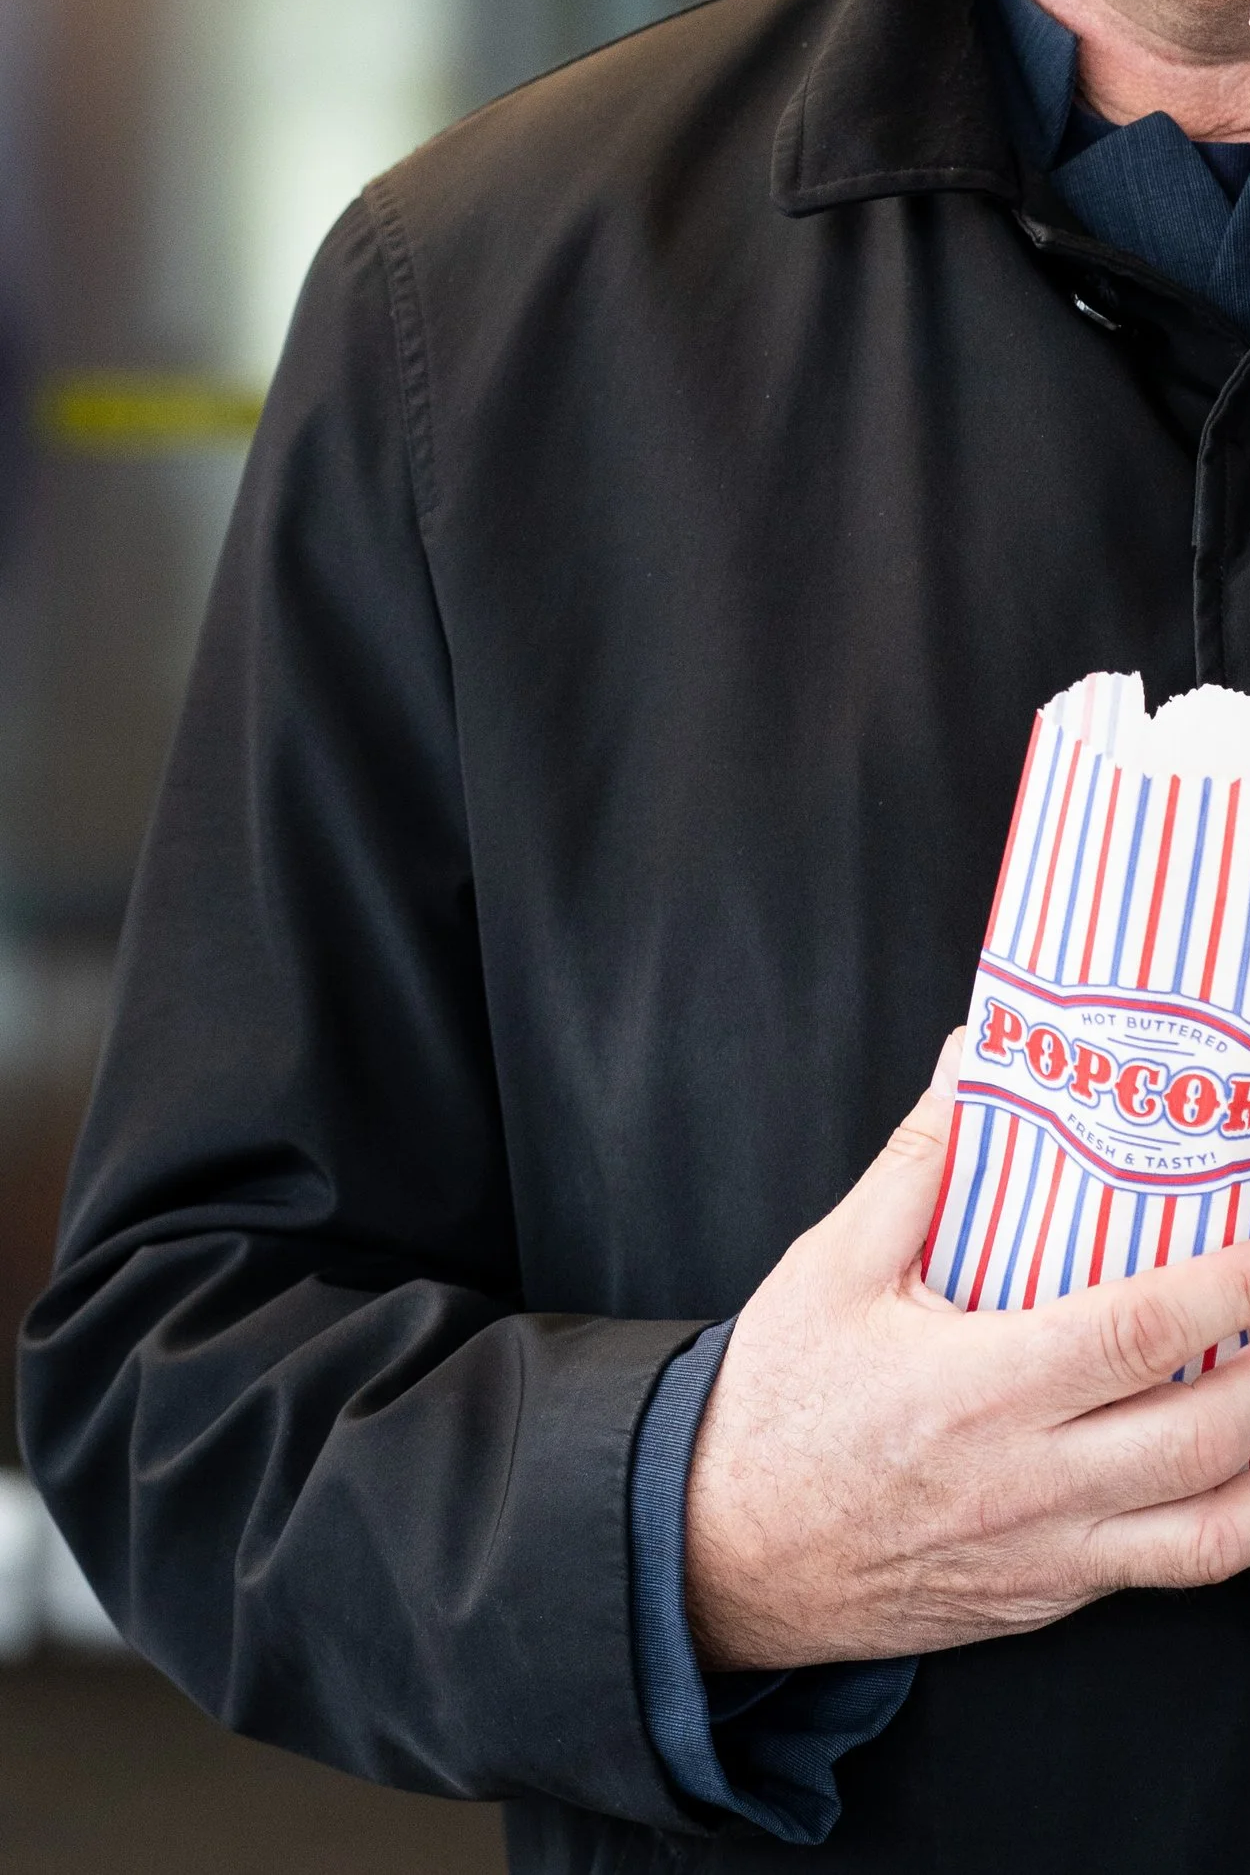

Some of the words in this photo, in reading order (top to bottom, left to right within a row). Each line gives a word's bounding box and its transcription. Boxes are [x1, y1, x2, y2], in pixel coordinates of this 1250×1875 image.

[1081, 1012, 1117, 1026] HOT
[1126, 1015, 1229, 1054] BUTTERED
[1066, 1112, 1116, 1159] FRESH
[1124, 1152, 1135, 1166] &
[1145, 1151, 1218, 1169] TASTY!
